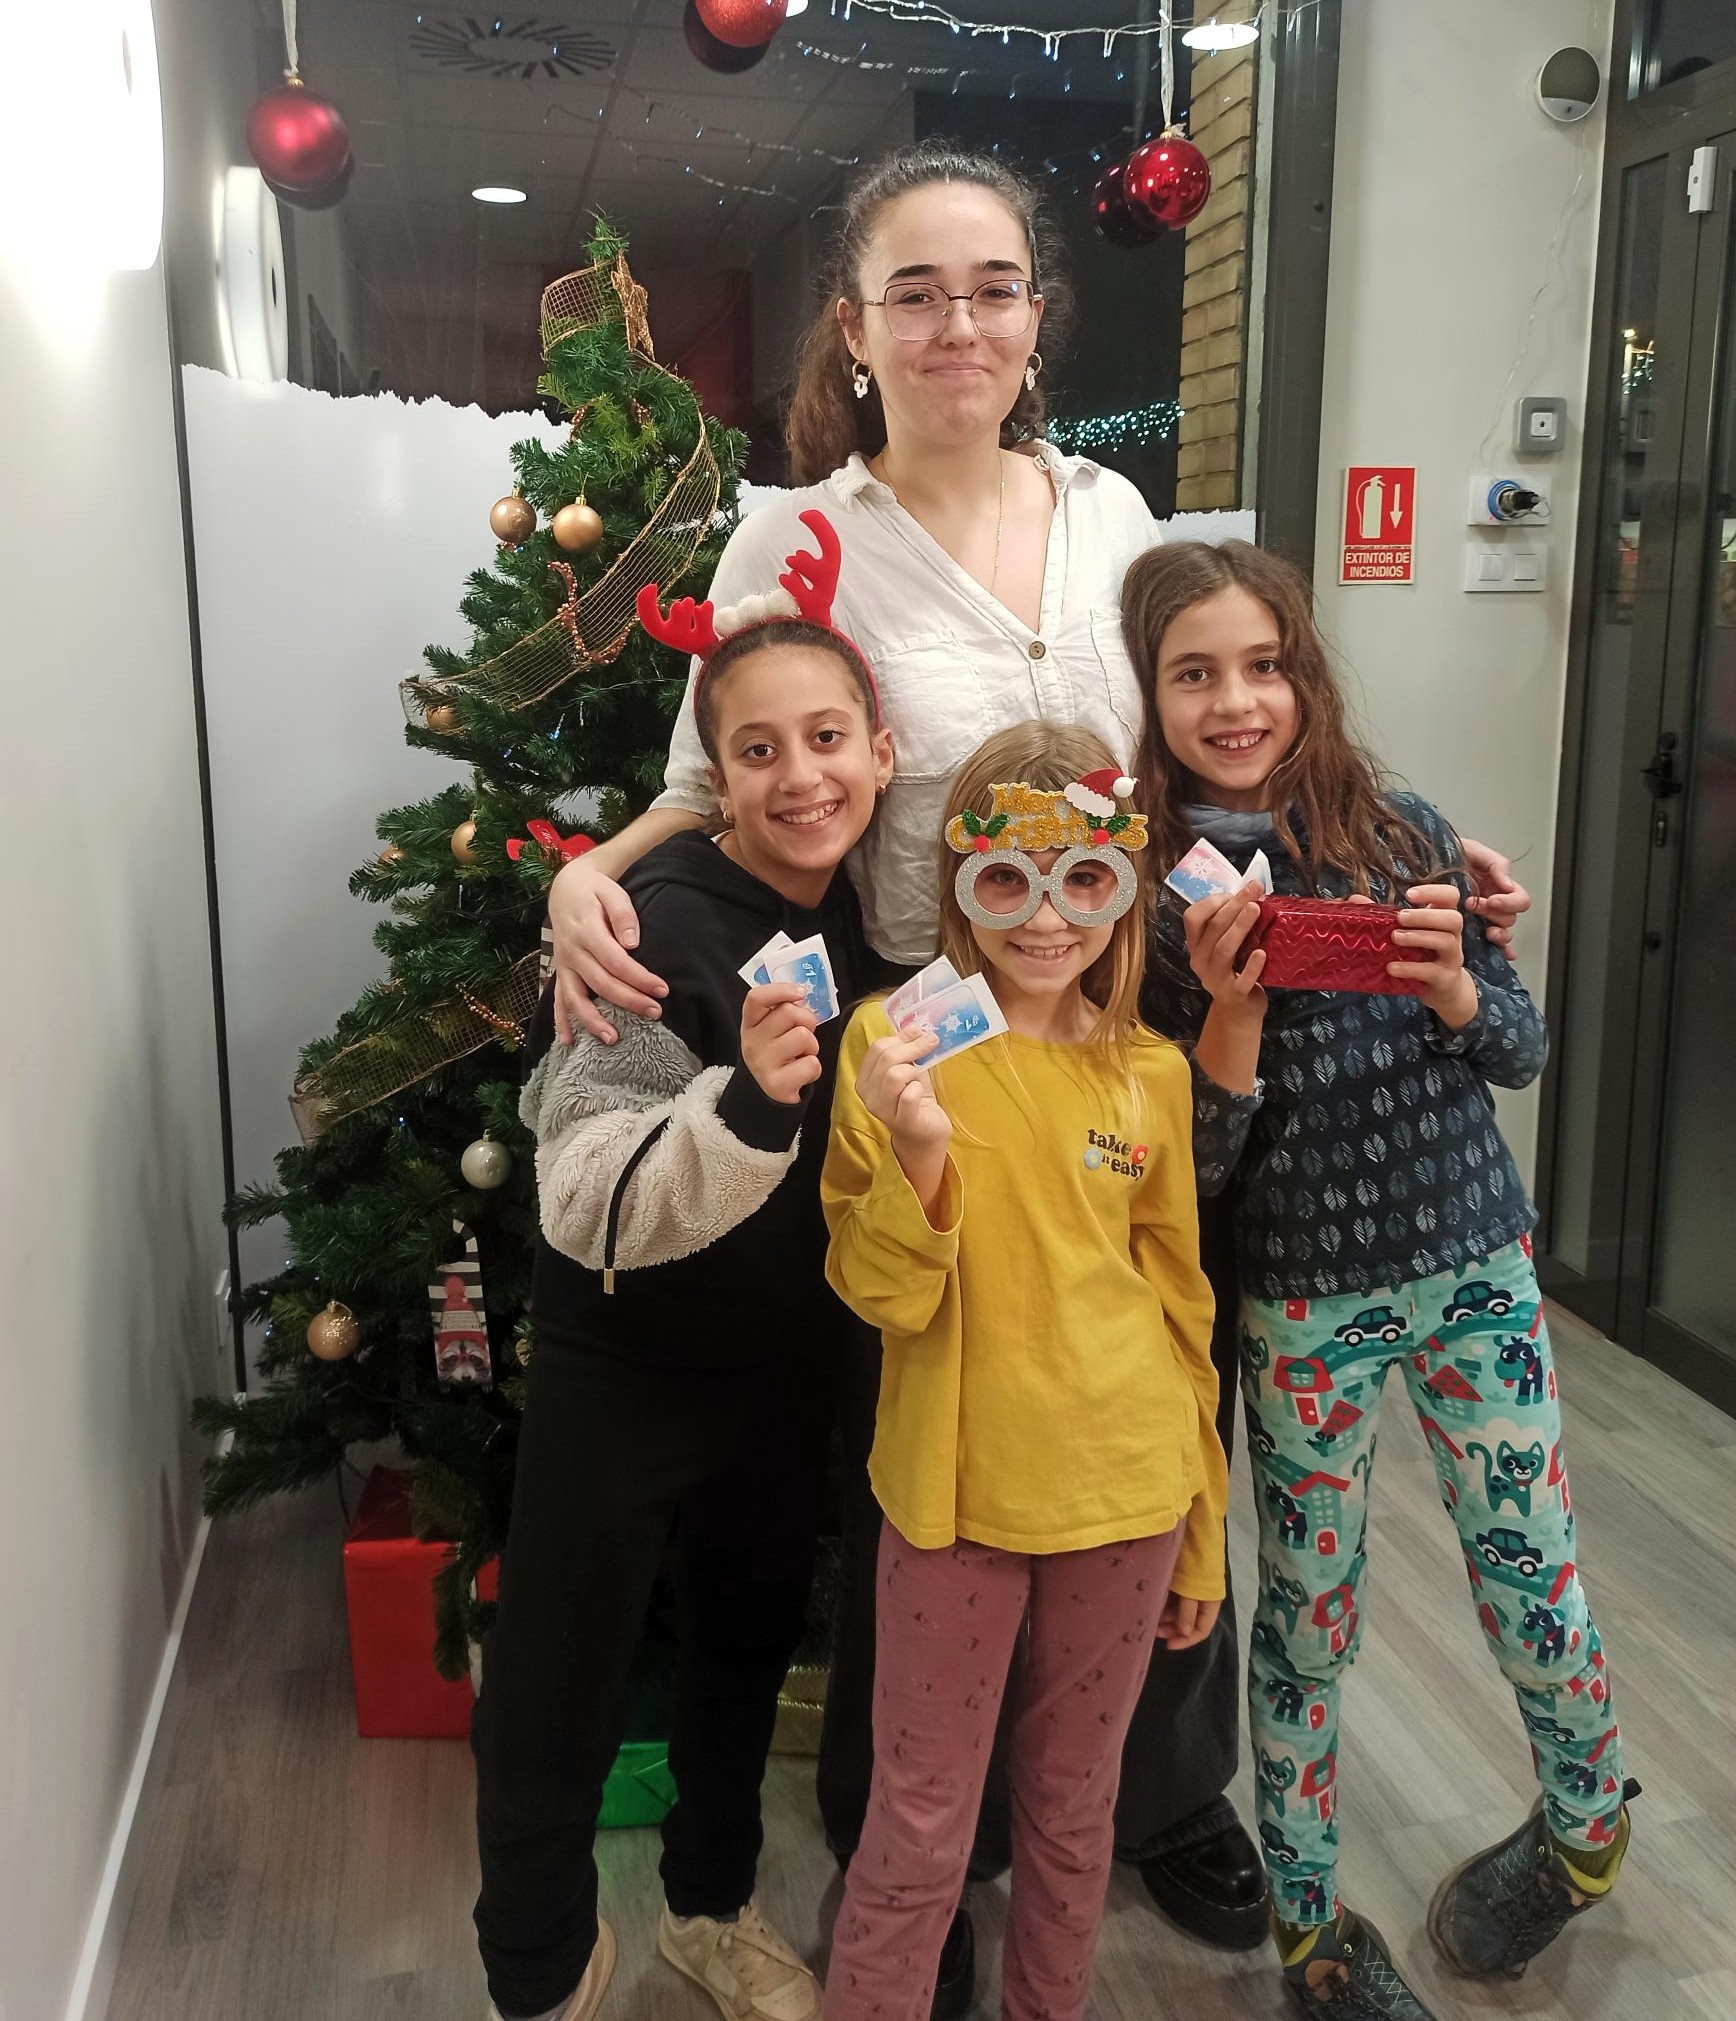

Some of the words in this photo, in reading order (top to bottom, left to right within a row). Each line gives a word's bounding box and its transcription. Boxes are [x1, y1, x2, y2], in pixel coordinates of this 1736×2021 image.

[1345, 552, 1394, 564] EXTINTOR
[1395, 552, 1410, 564] DE
[1350, 566, 1404, 577] INCENDIOS
[1087, 1128, 1132, 1156] take
[1110, 1158, 1145, 1182] easy
